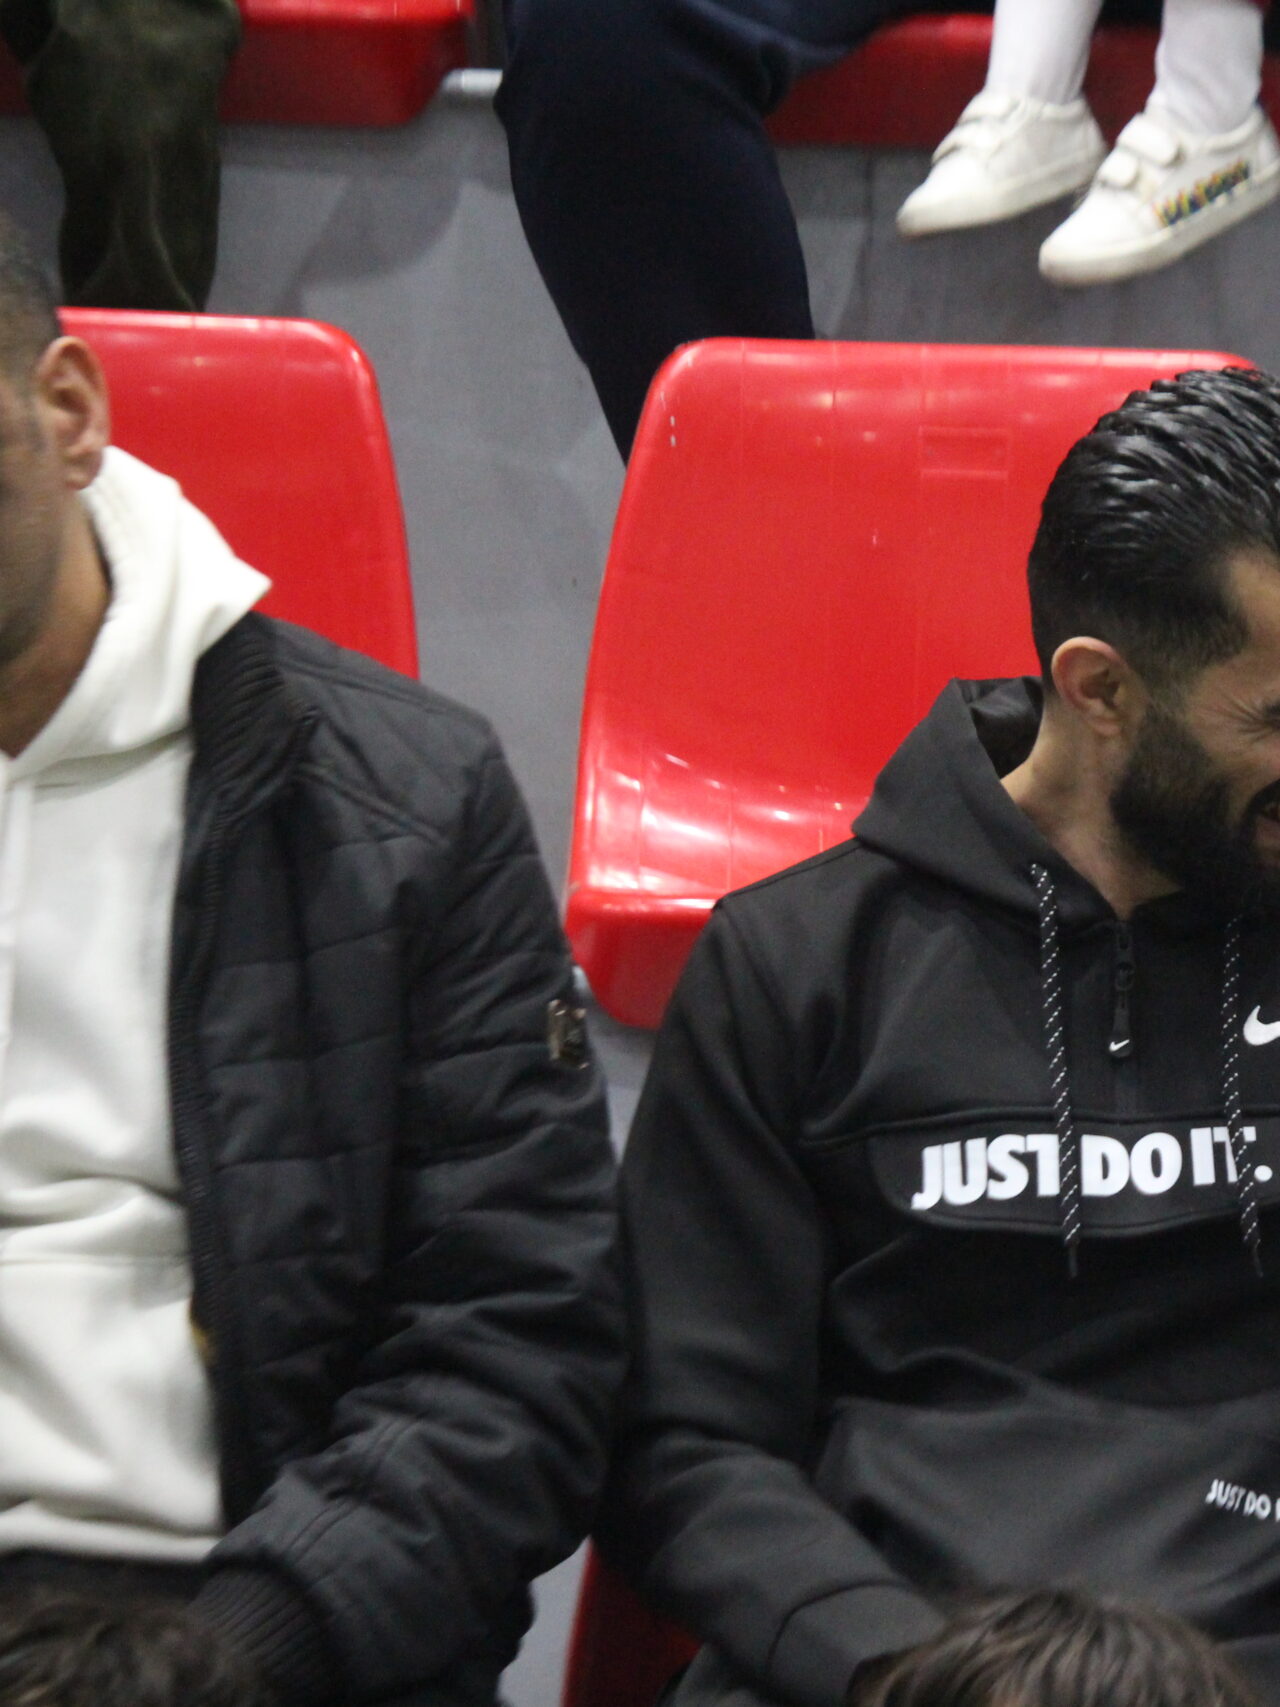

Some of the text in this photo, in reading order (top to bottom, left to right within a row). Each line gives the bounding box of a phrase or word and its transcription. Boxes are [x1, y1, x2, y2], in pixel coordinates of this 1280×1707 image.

[911, 1132, 1062, 1210] JUST
[1081, 1131, 1182, 1197] DO
[1205, 1479, 1247, 1512] JUST
[1243, 1490, 1272, 1520] DO
